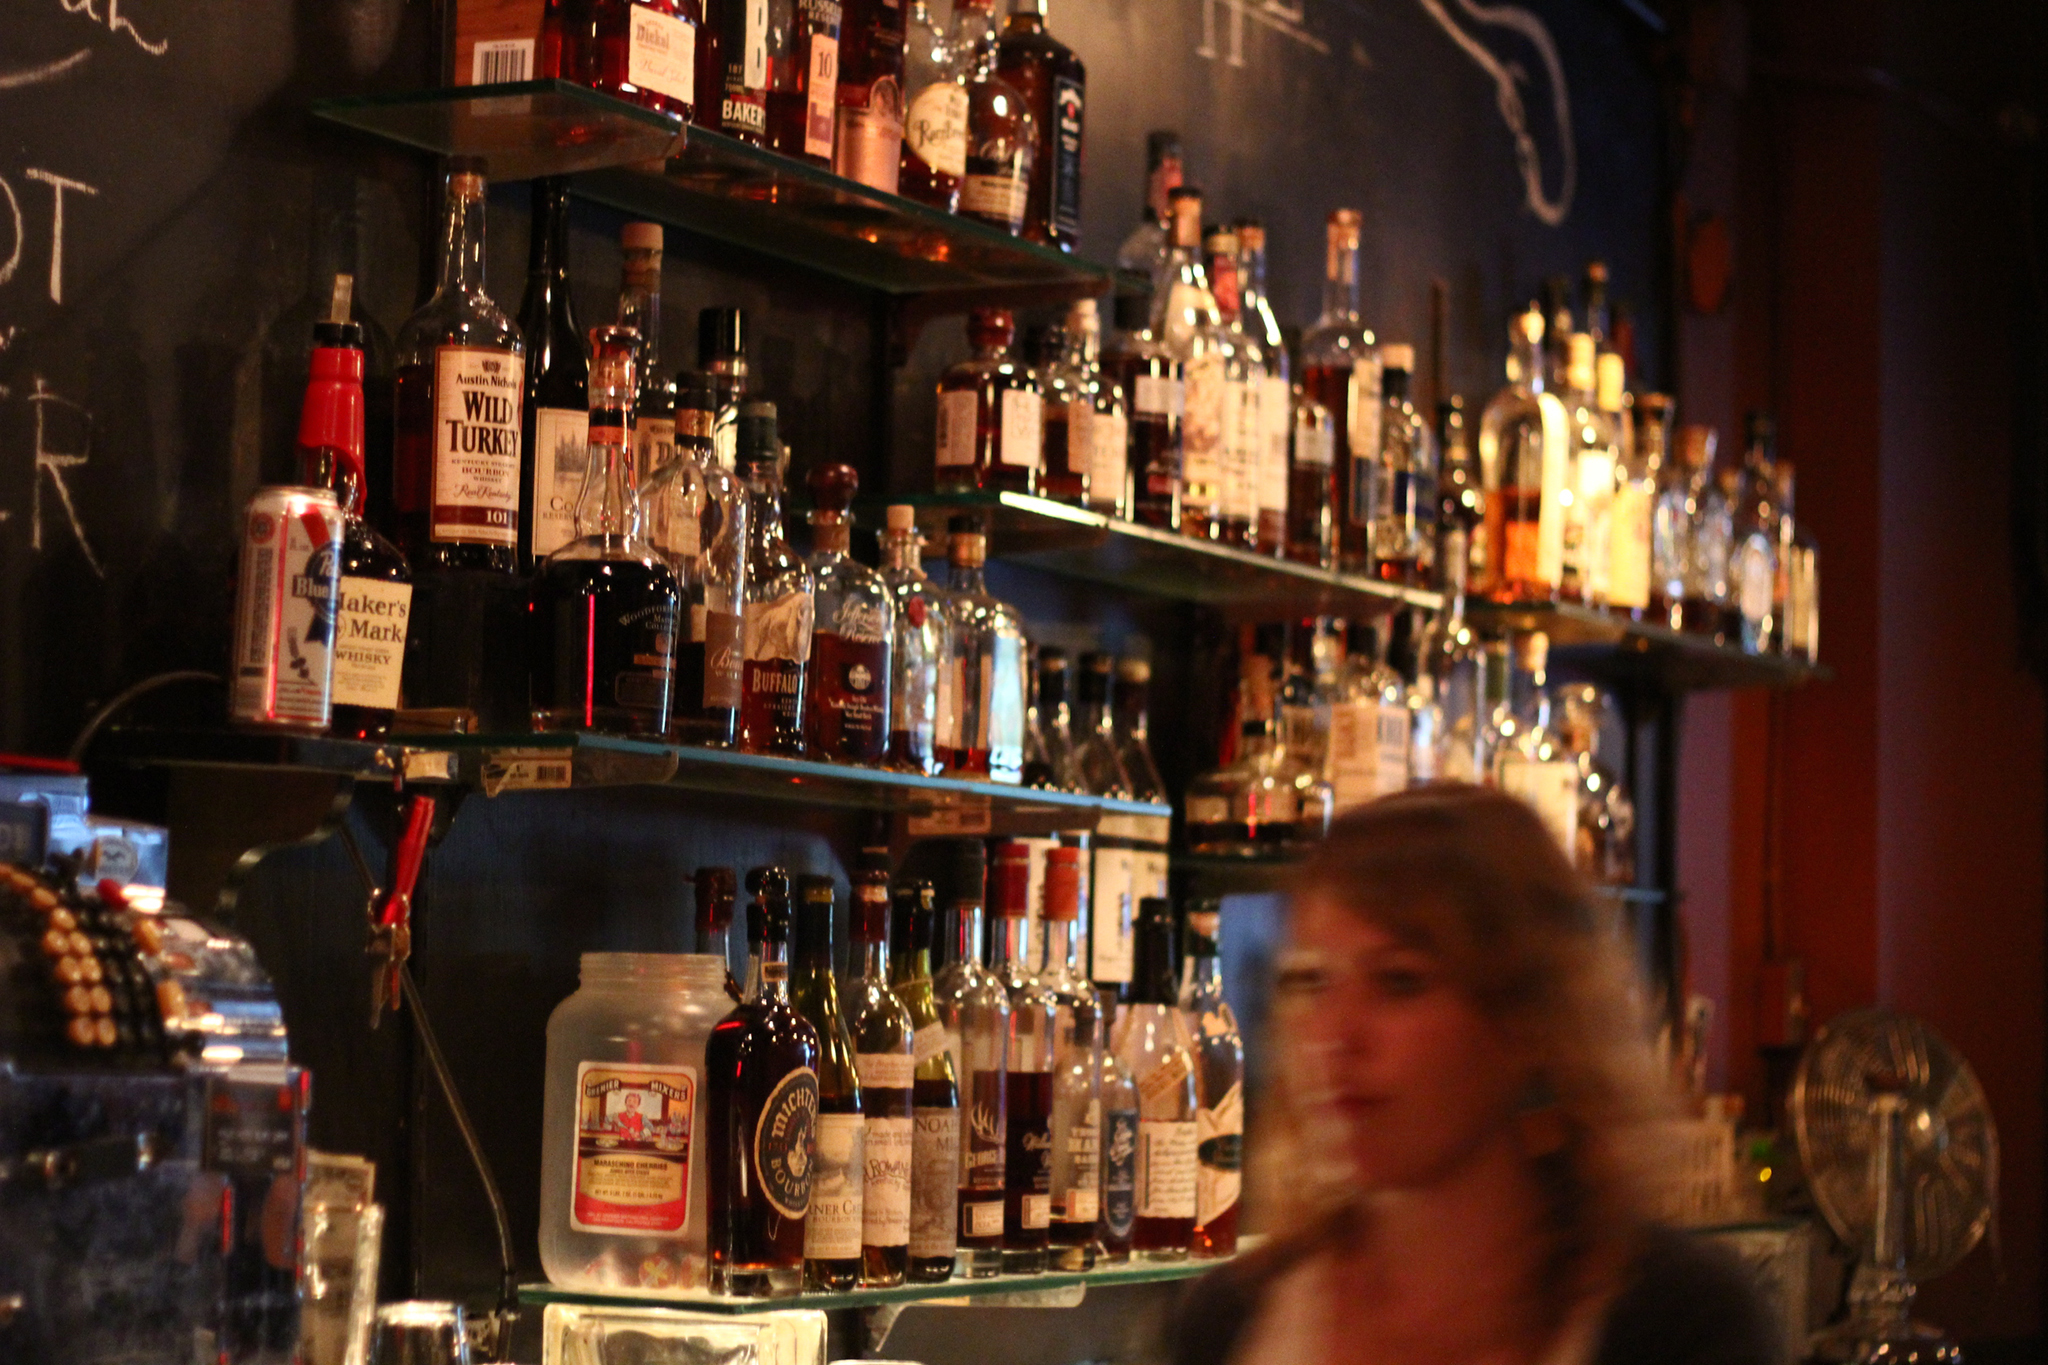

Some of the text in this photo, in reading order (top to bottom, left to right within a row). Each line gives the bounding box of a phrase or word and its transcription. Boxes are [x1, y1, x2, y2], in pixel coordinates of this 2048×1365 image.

[818, 51, 832, 78] 10
[456, 373, 489, 386] Austin
[462, 390, 513, 425] WILD
[445, 419, 519, 458] TURKEY
[461, 466, 510, 477] BOURBON
[486, 509, 508, 525] 101
[295, 576, 329, 598] Blue
[349, 617, 403, 644] Mark
[334, 649, 392, 666] WHISKY
[751, 666, 798, 694] BUFFALO
[651, 1081, 687, 1101] MIXERS
[770, 1157, 814, 1198] BOURBON
